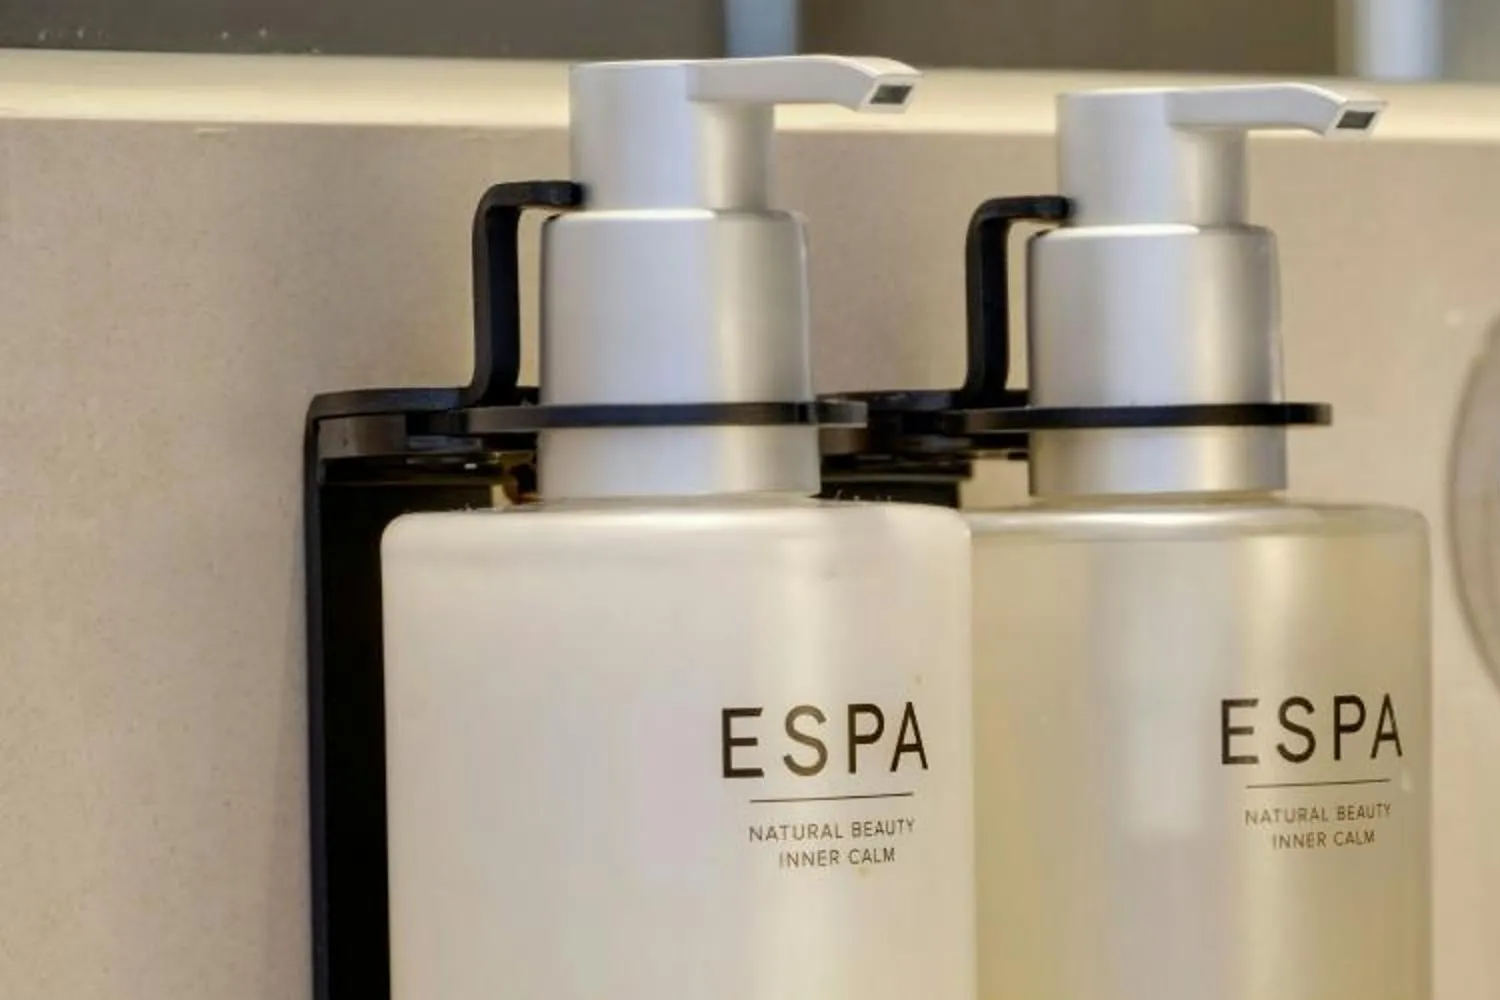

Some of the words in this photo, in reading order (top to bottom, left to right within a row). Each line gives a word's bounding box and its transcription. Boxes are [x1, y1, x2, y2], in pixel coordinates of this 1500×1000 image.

[721, 701, 928, 778] ESPA
[1220, 692, 1403, 765] ESPA
[1244, 807, 1329, 825] NATURAL
[1336, 803, 1392, 821] BEAUTY
[749, 823, 844, 843] NATURAL
[851, 818, 916, 838] BEAUTY
[1272, 832, 1326, 849] INNER
[1333, 829, 1376, 847] CALM
[779, 850, 840, 869] INNER
[848, 847, 896, 865] CALM
